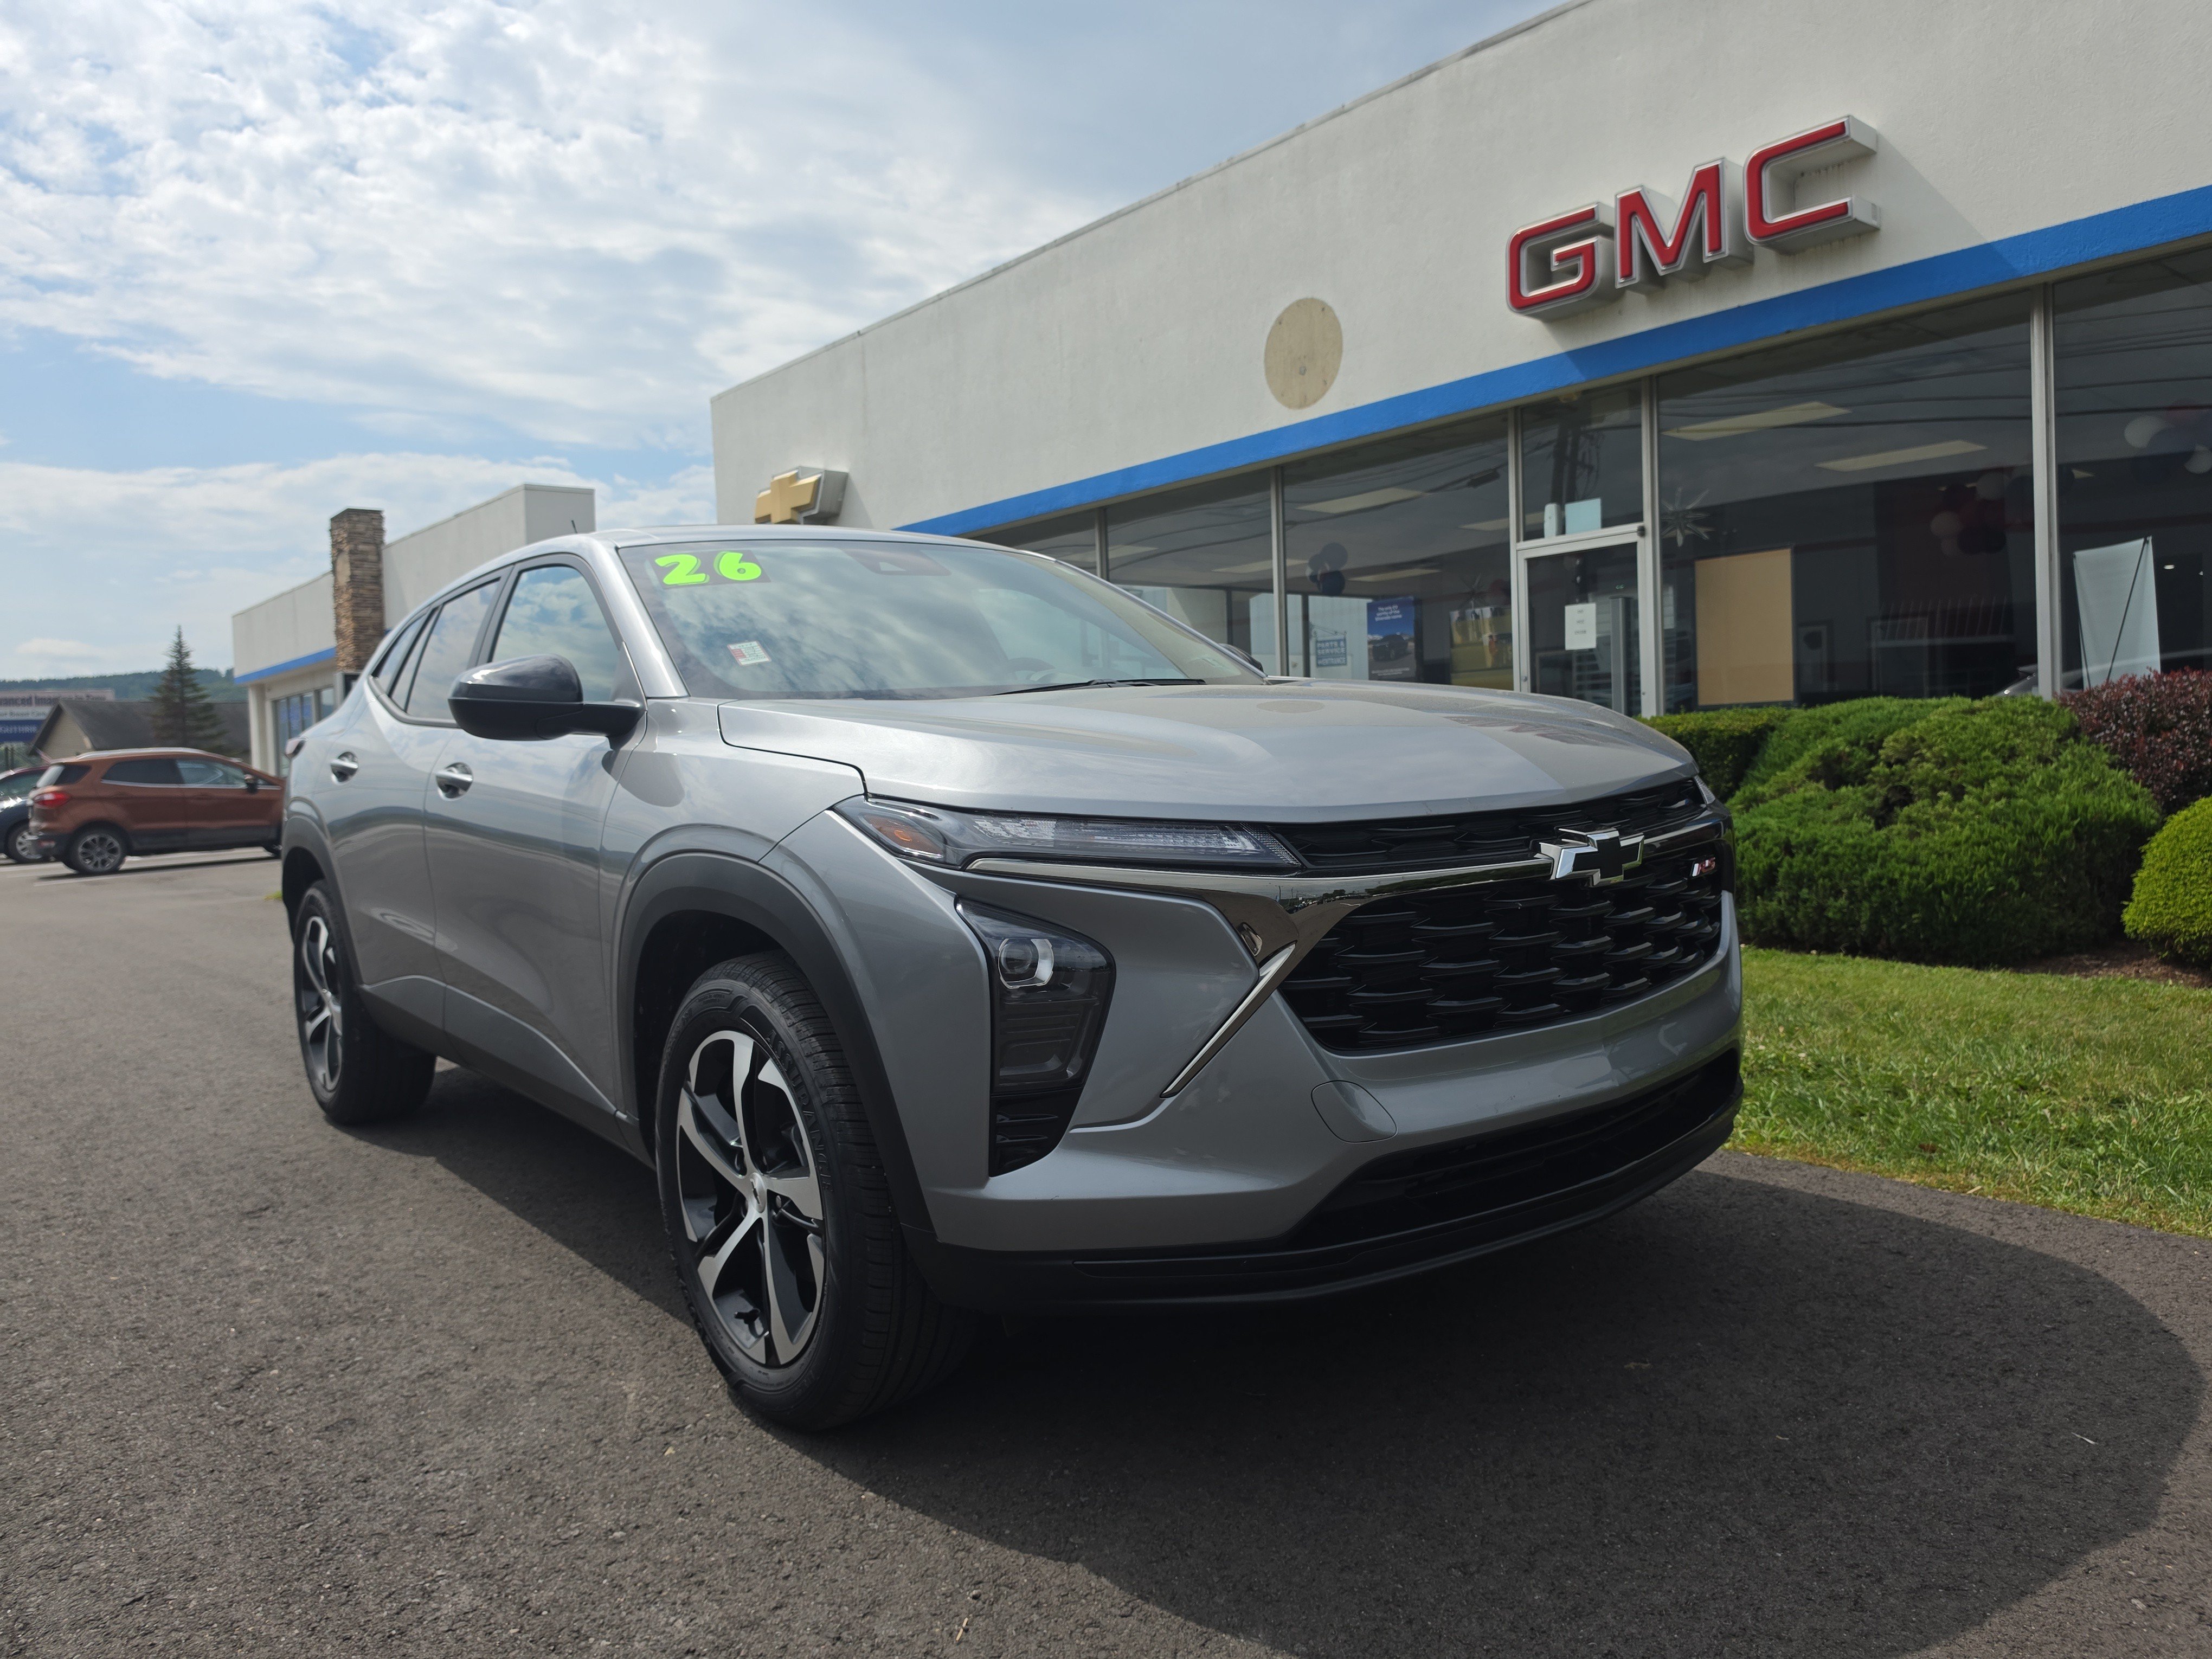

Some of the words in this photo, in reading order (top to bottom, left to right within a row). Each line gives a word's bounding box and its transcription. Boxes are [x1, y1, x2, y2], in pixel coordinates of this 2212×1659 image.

[1506, 114, 1855, 314] GMC
[654, 550, 762, 586] 26
[1692, 857, 1716, 877] RS
